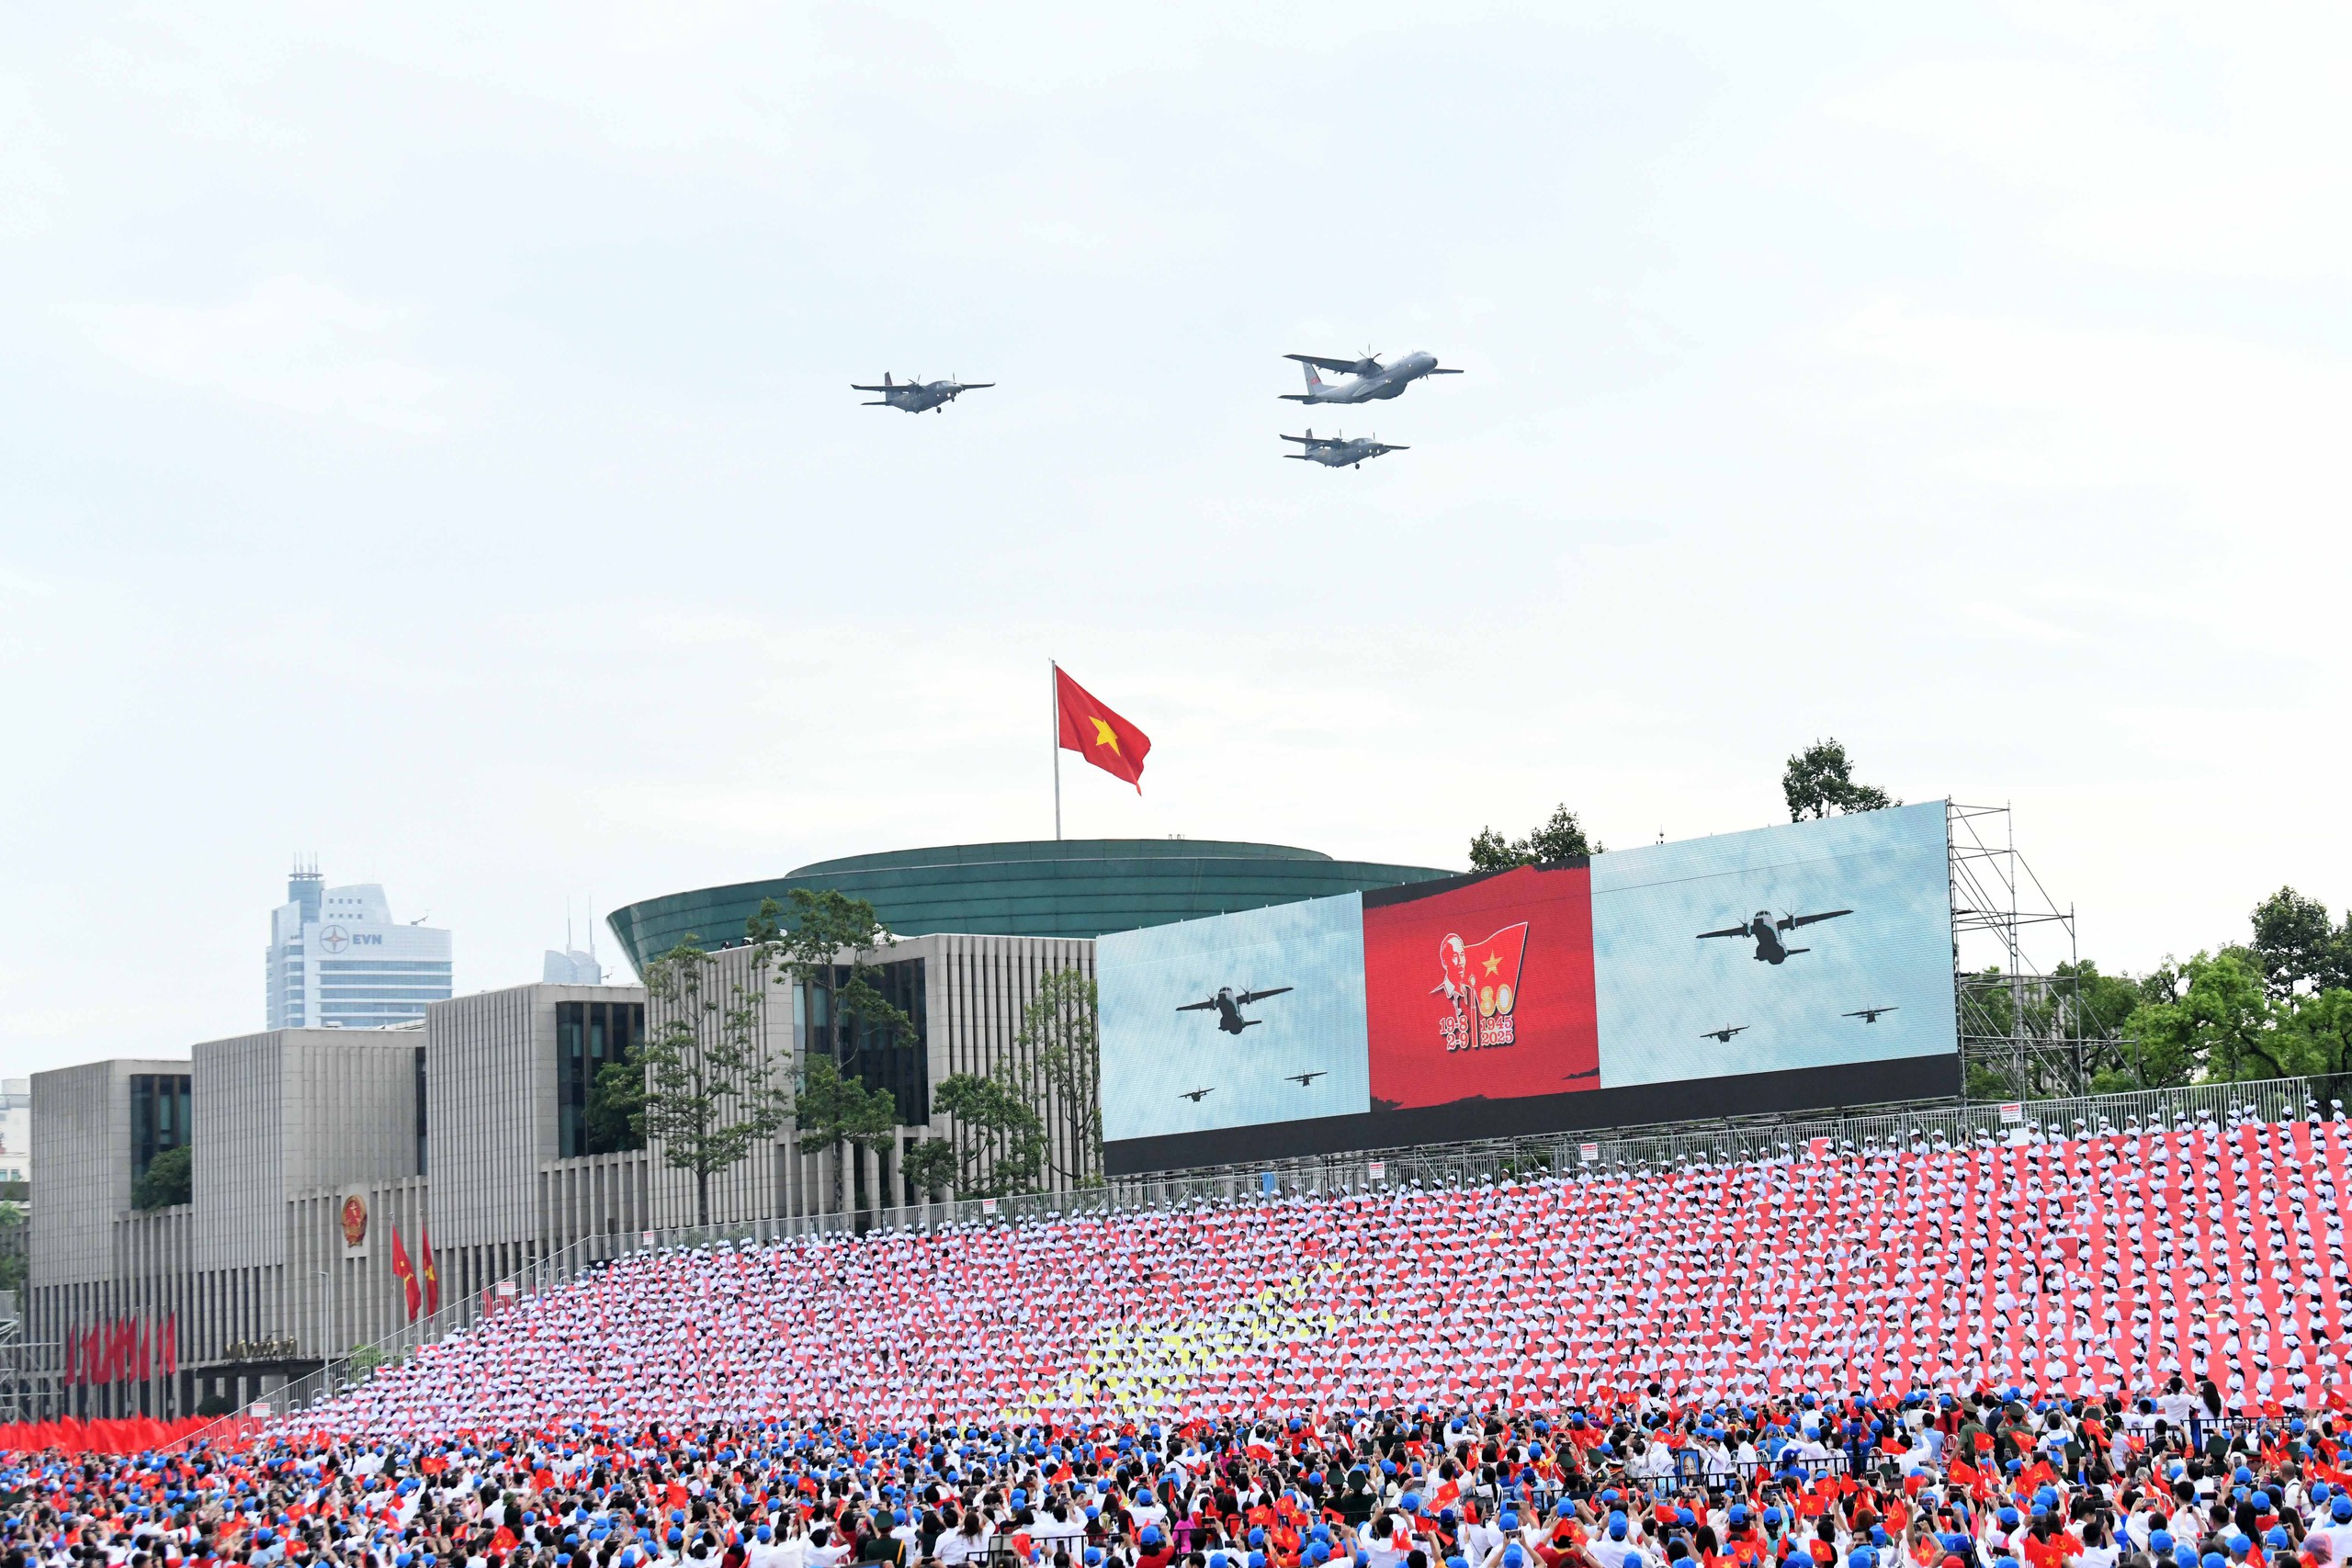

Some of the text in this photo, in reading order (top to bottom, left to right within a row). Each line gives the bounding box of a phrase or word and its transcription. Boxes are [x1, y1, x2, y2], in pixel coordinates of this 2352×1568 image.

[353, 934, 382, 944] EVN
[1480, 984, 1512, 1017] 80
[1440, 1015, 1468, 1034] 19-8
[1480, 1015, 1513, 1032] 1945
[1447, 1032, 1469, 1050] 2-9
[1481, 1031, 1513, 1046] 2025
